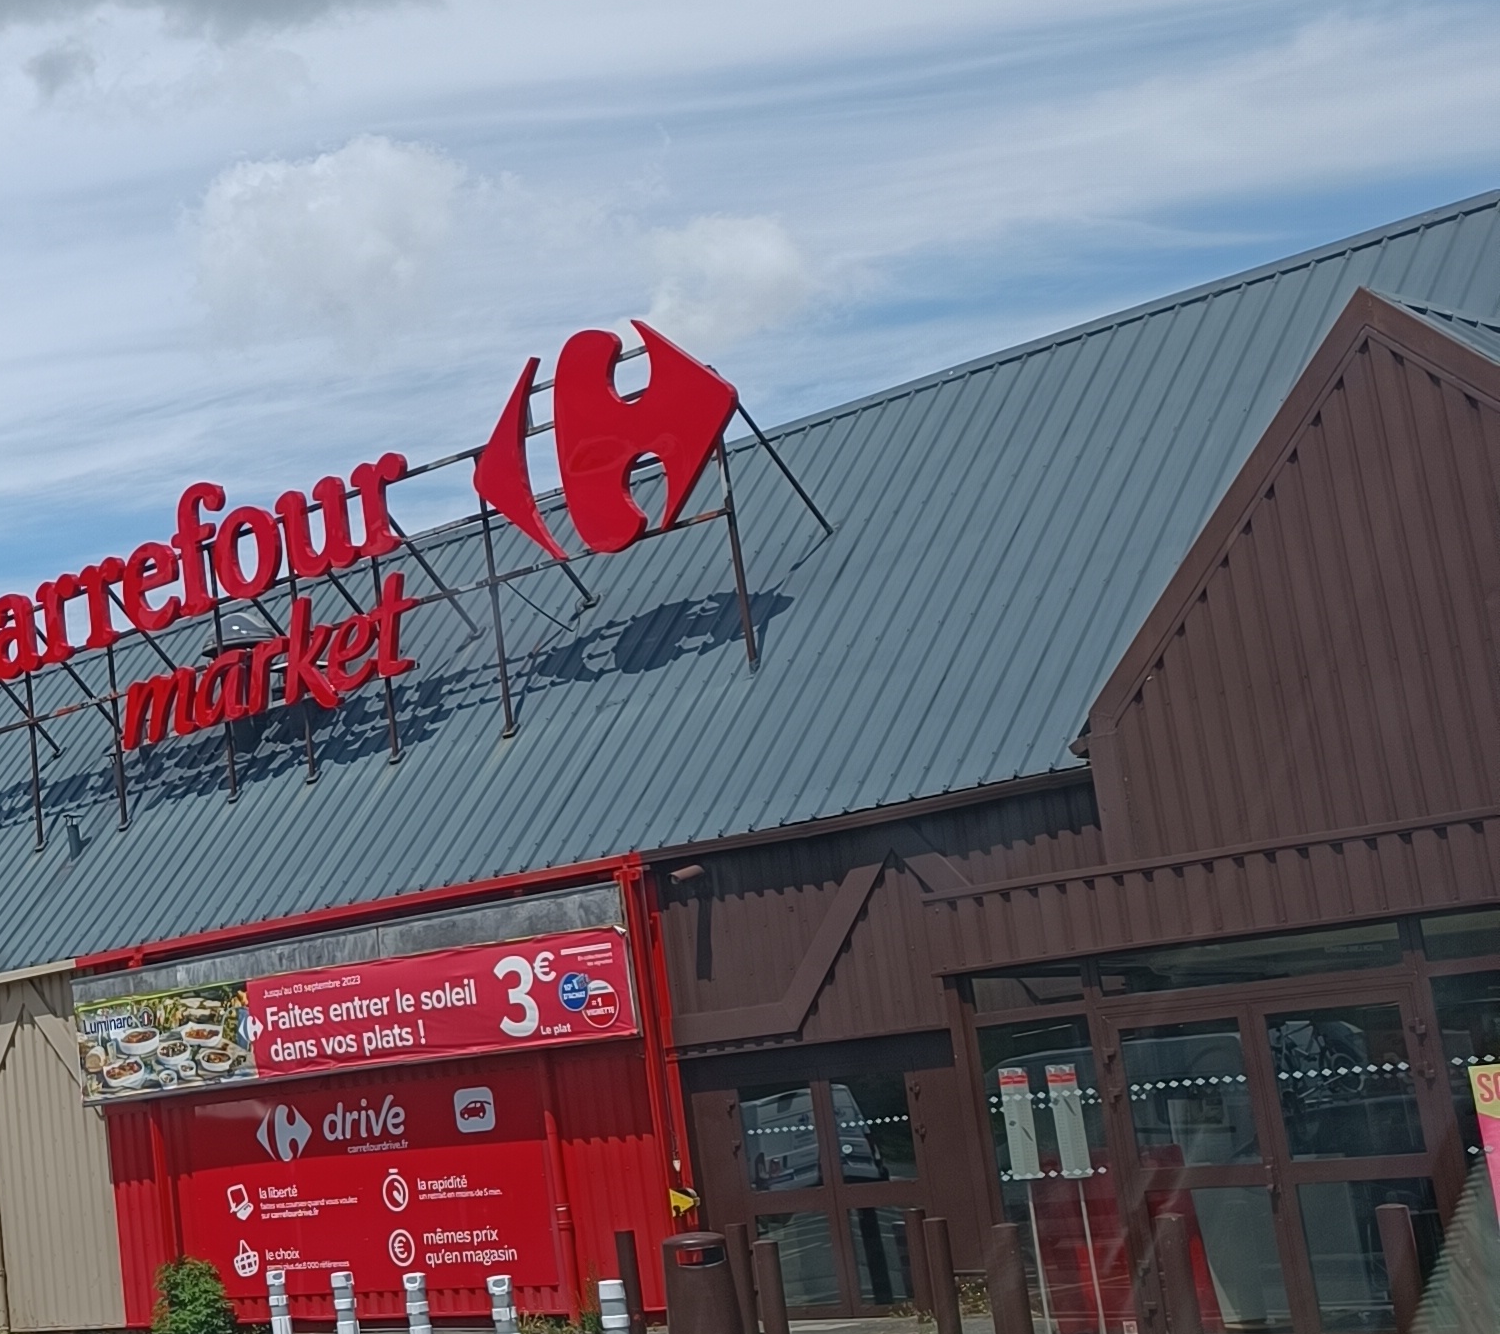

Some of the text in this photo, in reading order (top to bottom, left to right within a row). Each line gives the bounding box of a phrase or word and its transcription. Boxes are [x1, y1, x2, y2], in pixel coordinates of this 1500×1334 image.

[123, 572, 418, 751] market
[293, 984, 303, 993] 03
[304, 980, 341, 992] septembre
[341, 975, 361, 986] 2023
[266, 979, 477, 1031] Faites entrer le soleil
[83, 1014, 133, 1035] Luminarc
[540, 1022, 572, 1036] Le plat
[270, 1038, 317, 1061] dans
[321, 1033, 358, 1055] vos
[363, 1023, 414, 1056] plats
[323, 1094, 406, 1141] drive
[347, 1139, 409, 1153] carrefourdrive.fr
[259, 1184, 298, 1199] la liberté
[417, 1175, 468, 1192] la rapidité
[423, 1226, 499, 1246] mêmes prix
[265, 1247, 300, 1261] le choix
[425, 1245, 518, 1268] qu'en magasin
